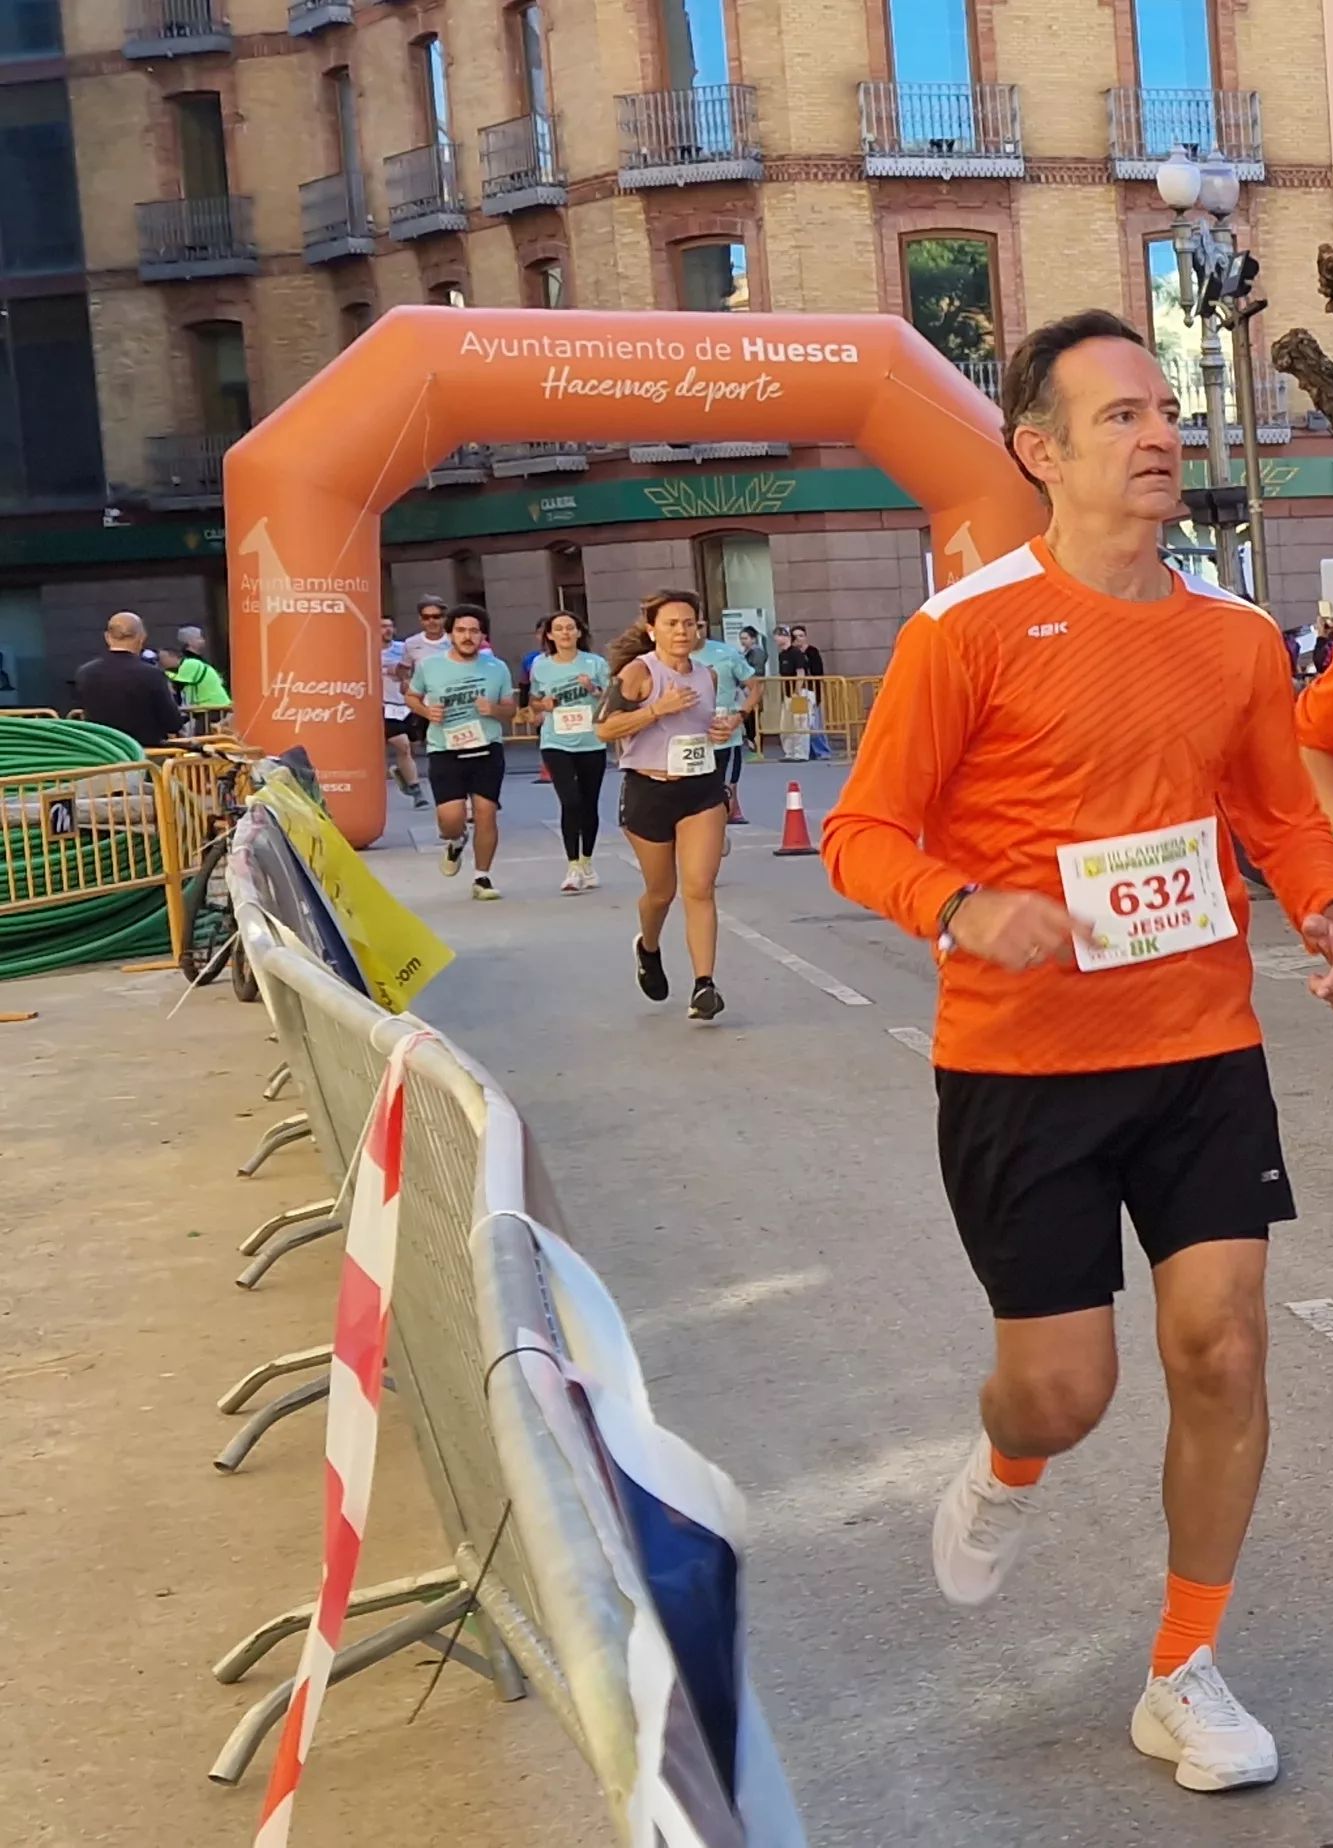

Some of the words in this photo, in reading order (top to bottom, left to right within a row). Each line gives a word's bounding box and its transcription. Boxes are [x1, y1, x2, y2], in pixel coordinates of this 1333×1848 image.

[460, 330, 685, 363] Ayuntamiento
[695, 337, 732, 361] de
[741, 336, 859, 363] Huesca
[541, 365, 670, 404] Hacemos
[674, 366, 784, 412] deporte
[241, 573, 370, 596] Ayuntamiento
[242, 595, 259, 614] de
[266, 596, 346, 615] Huesca
[271, 671, 367, 699] Hacemos
[272, 696, 356, 734] deporte
[320, 783, 352, 793] esca
[1109, 867, 1195, 917] 632
[1128, 908, 1192, 938] JESUS
